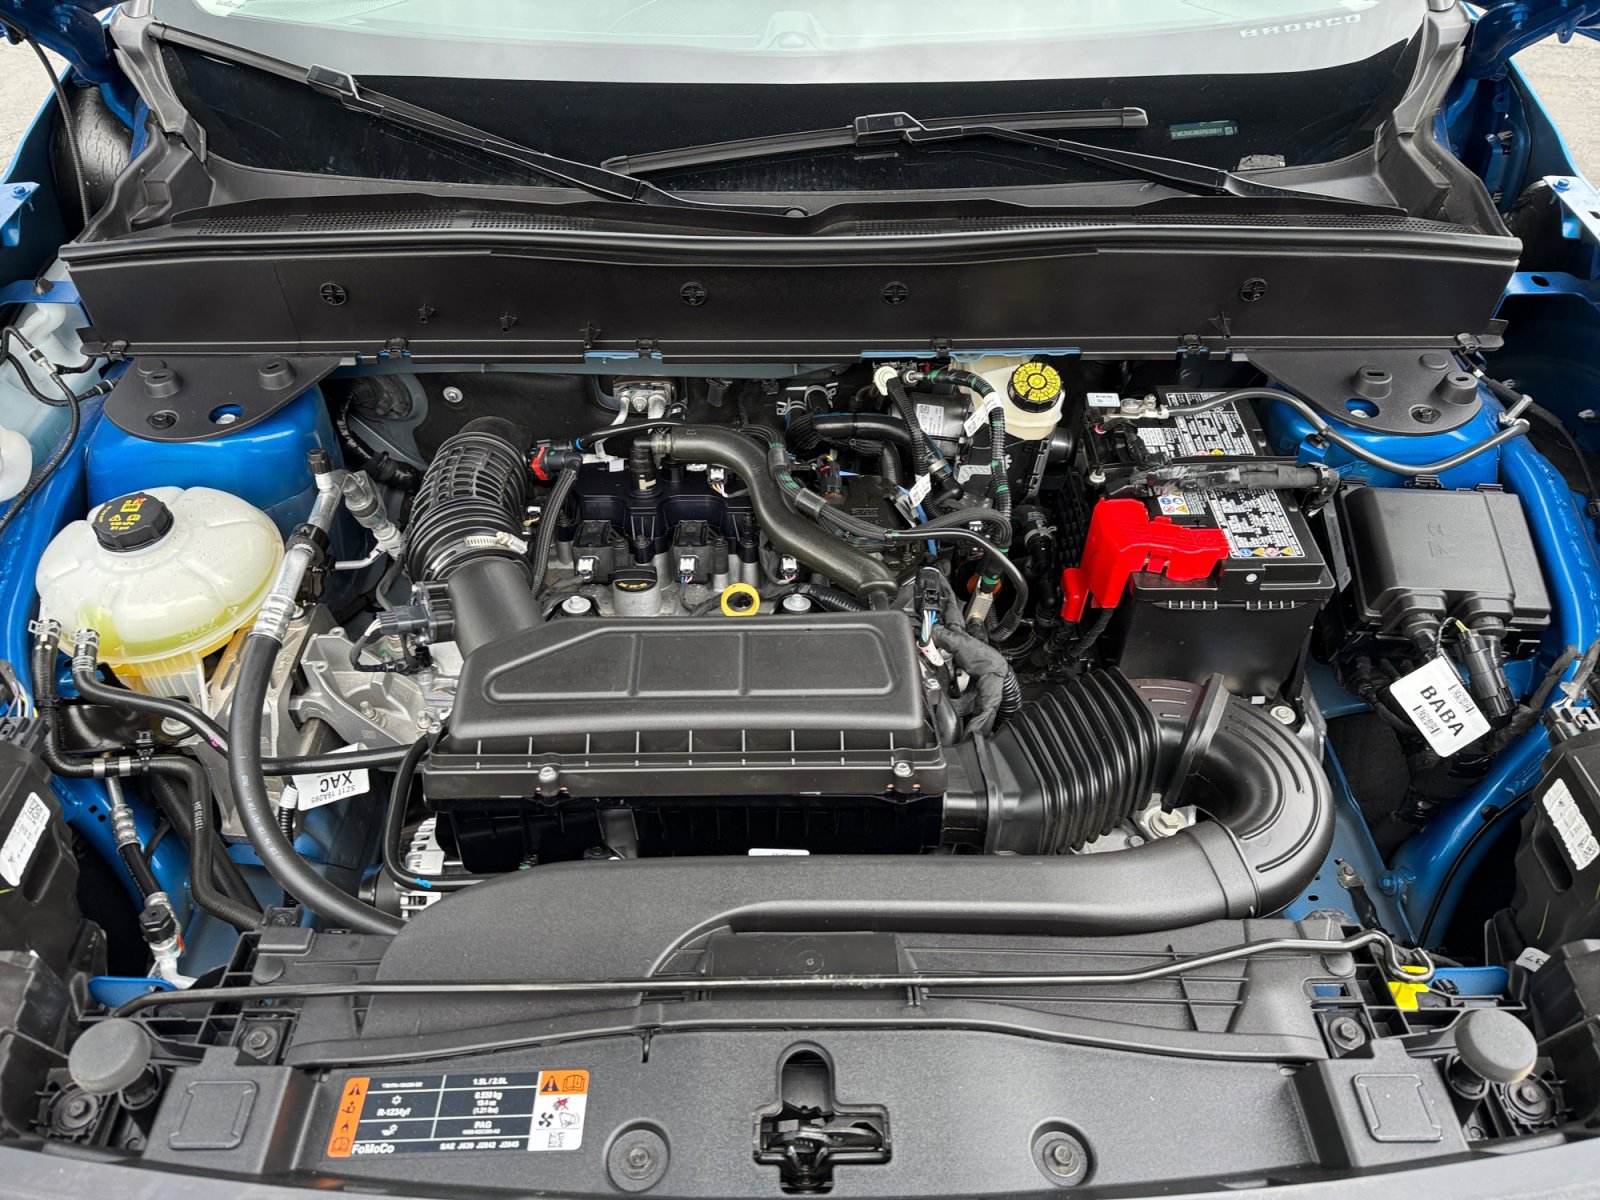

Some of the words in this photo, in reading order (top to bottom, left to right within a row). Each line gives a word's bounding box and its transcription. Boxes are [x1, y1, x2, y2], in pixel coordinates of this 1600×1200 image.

[1240, 13, 1361, 38] BRONCO
[1420, 685, 1464, 737] BABA
[320, 770, 353, 793] XAC
[376, 1107, 412, 1118] R-1234yf
[474, 1120, 493, 1129] PAG
[351, 1143, 395, 1155] FoMoCo
[440, 1142, 456, 1150] SAE
